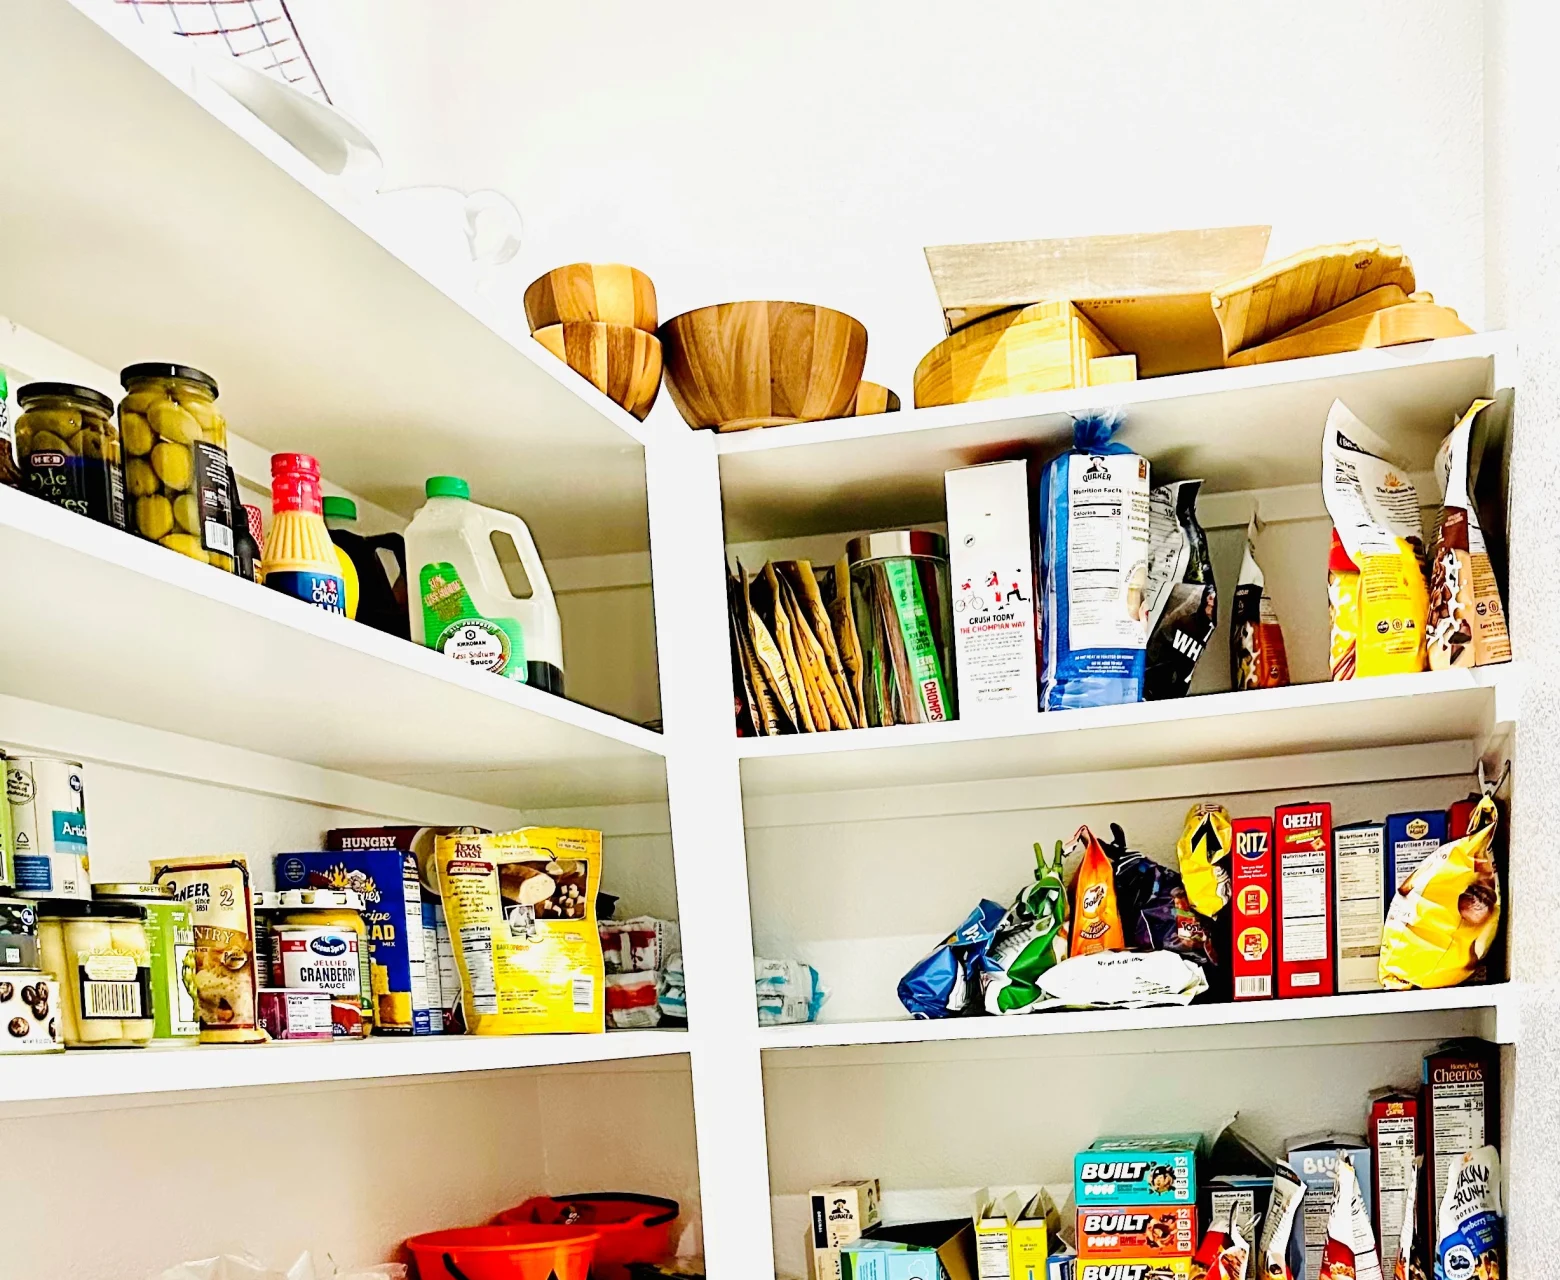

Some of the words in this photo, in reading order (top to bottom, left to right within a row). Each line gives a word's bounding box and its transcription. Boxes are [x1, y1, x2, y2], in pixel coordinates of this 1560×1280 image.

[1082, 472, 1112, 483] QUAKER
[1073, 488, 1102, 496] Nutrition
[1073, 509, 1097, 517] Calories
[1111, 508, 1122, 516] 35
[312, 578, 327, 592] LA
[313, 589, 339, 605] CHOY
[968, 615, 991, 625] CRUSH
[992, 613, 1015, 623] TODAY
[960, 627, 971, 635] THE
[973, 623, 1010, 634] CHOMPIAN
[1011, 621, 1026, 629] WAY
[456, 640, 487, 648] KIKKOMAN
[923, 680, 943, 721] CHOMPS
[1282, 811, 1323, 829] CHEEZ-IT
[341, 836, 397, 849] HUNGRY
[454, 842, 482, 851] TEXAS
[1236, 831, 1268, 855] RITZ
[455, 849, 482, 859] TOAST
[196, 904, 208, 912] 1851
[193, 927, 235, 944] NTRY
[311, 941, 330, 953] Ocean
[330, 940, 346, 954] Spray
[300, 967, 356, 982] CRANBERRY
[1450, 1063, 1468, 1071] Honey
[1433, 1069, 1483, 1083] Cheerios
[1081, 1162, 1149, 1181] BUILT
[829, 1213, 854, 1221] QUAKER
[1083, 1214, 1151, 1233] BUILT
